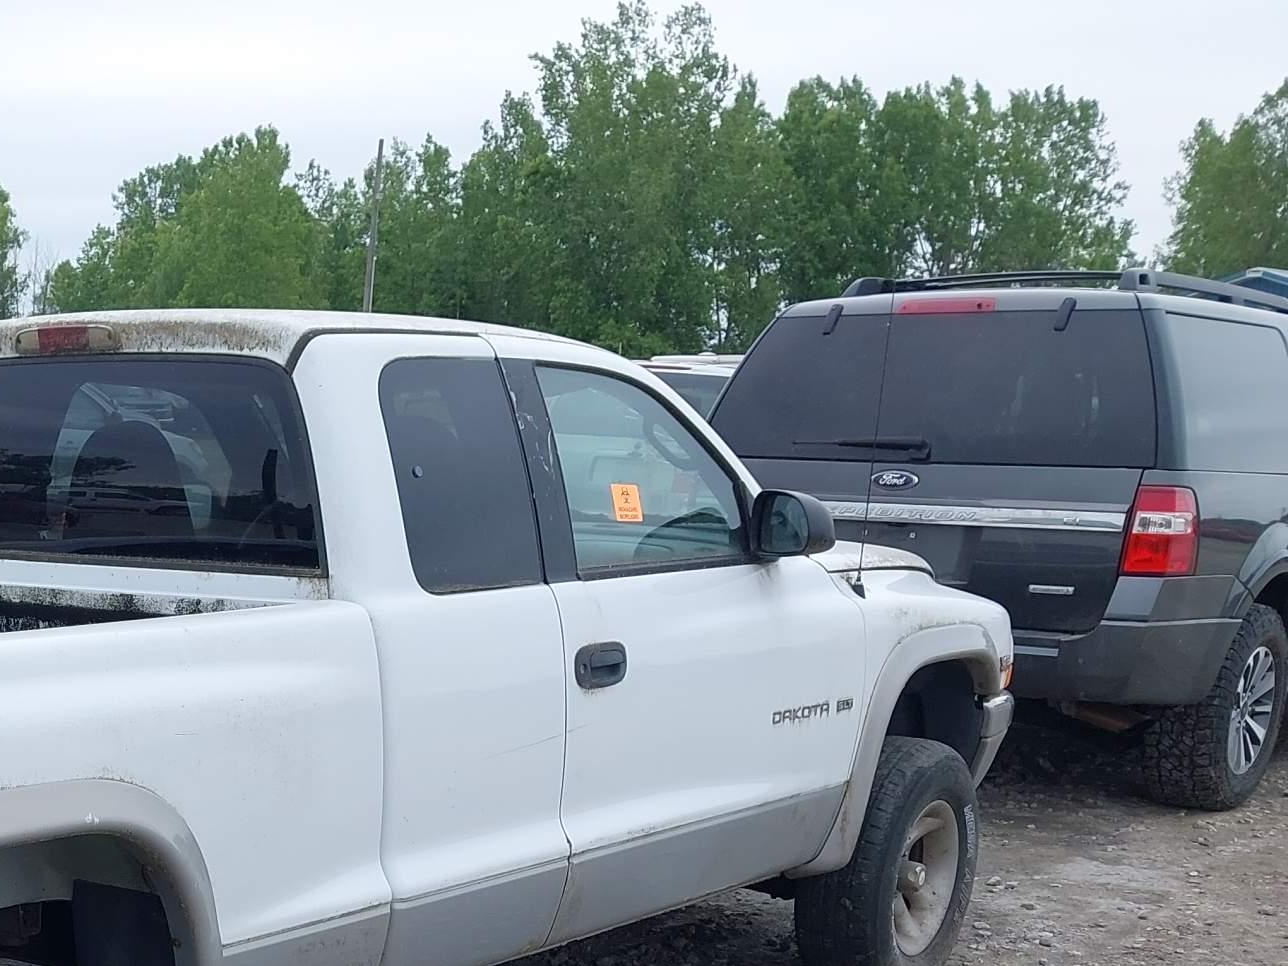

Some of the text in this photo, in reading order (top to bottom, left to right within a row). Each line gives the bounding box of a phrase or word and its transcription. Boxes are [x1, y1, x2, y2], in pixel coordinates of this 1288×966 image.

[879, 473, 906, 485] Ford
[772, 699, 854, 724] DAKOTA SLT
